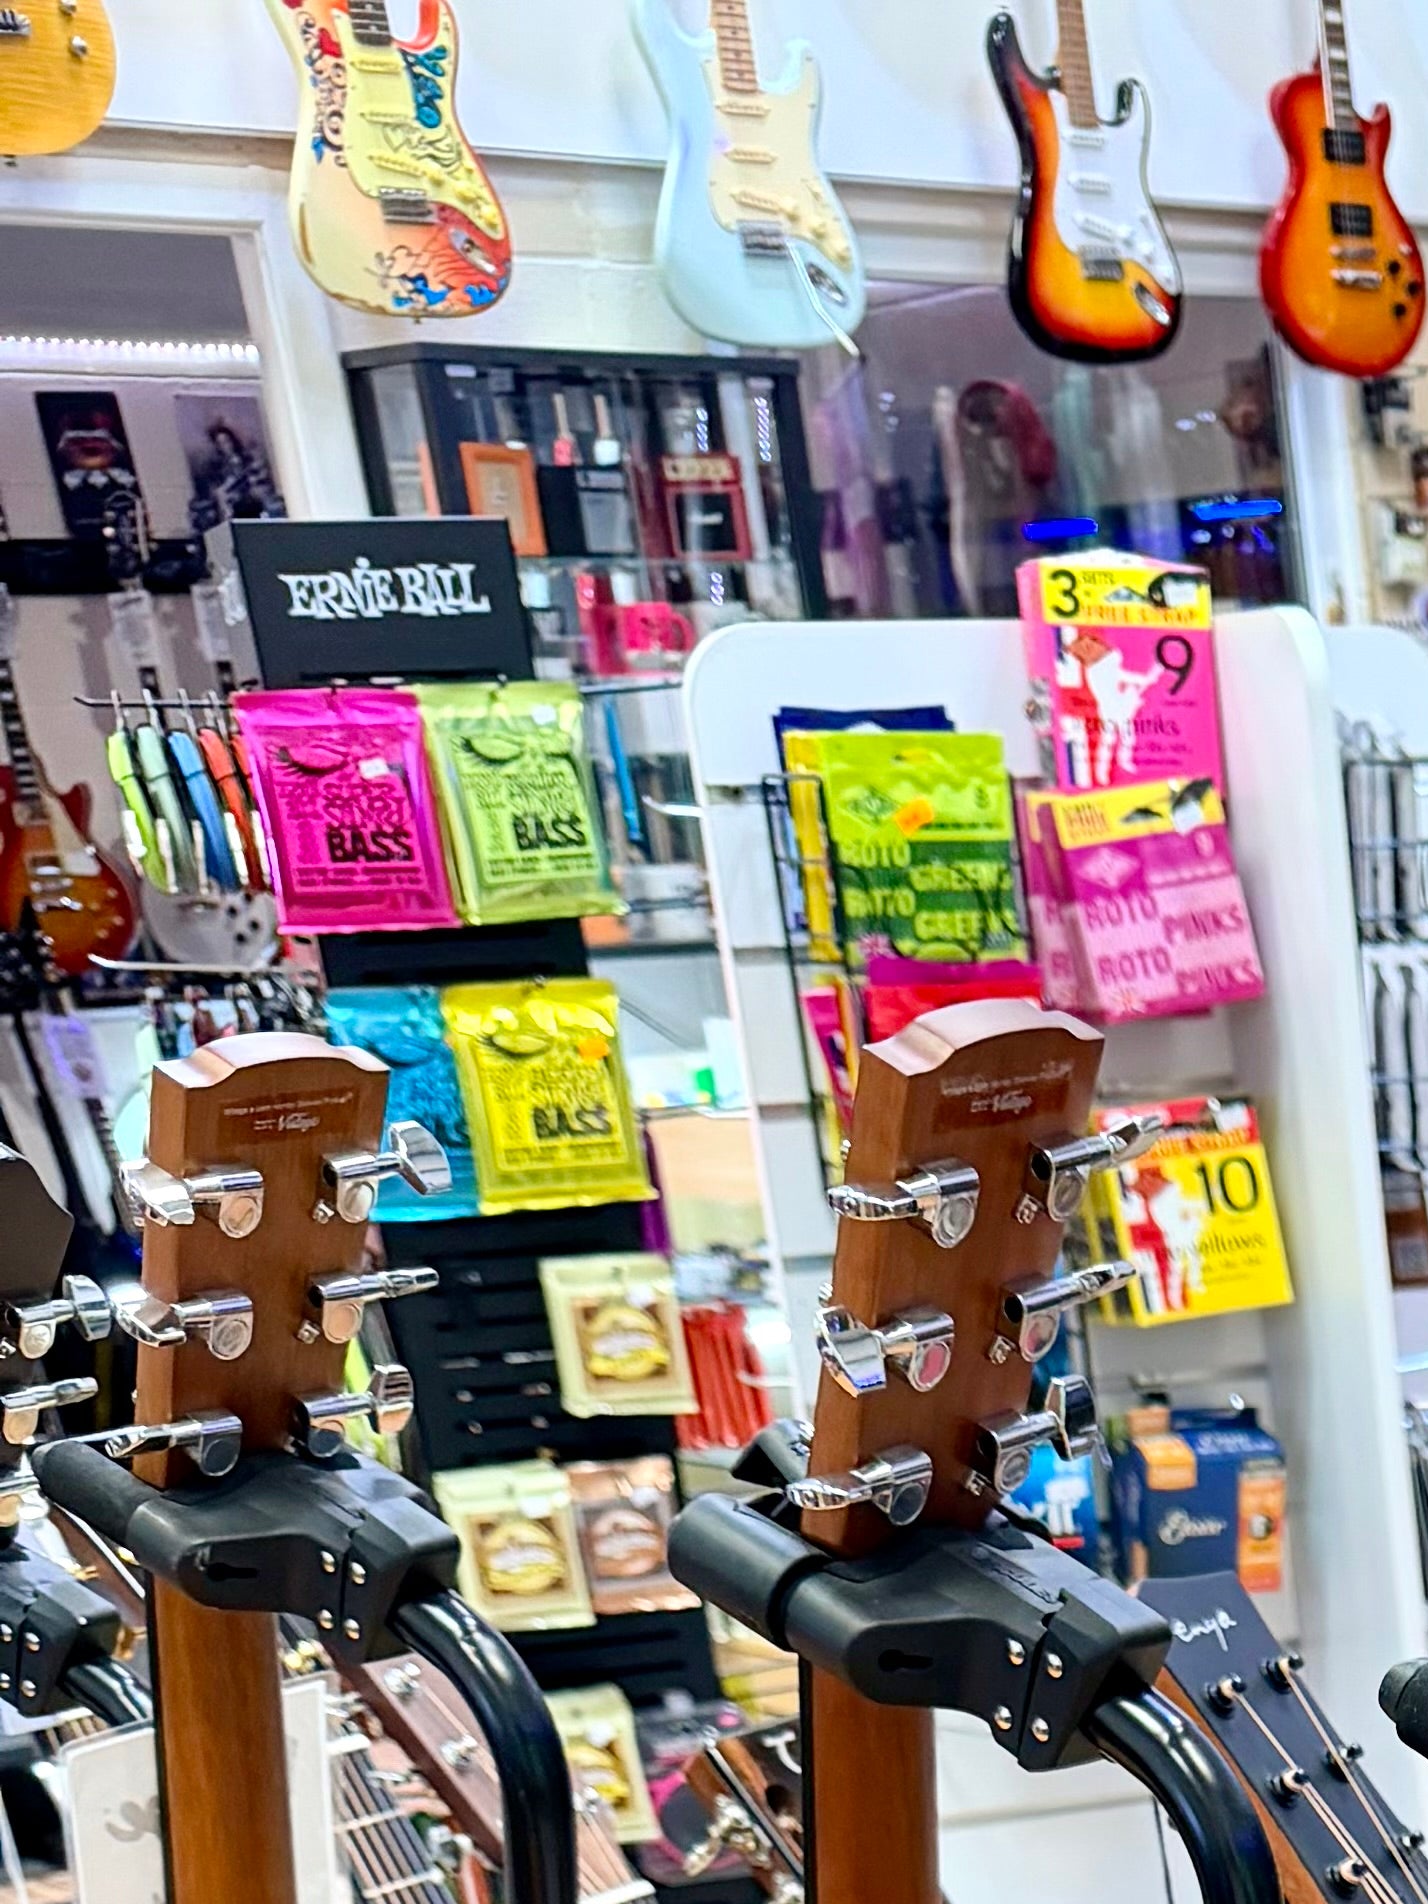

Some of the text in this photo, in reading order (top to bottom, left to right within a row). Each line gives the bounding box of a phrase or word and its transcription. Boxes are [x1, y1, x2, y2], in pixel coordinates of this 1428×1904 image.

[277, 556, 492, 620] ERNIE BALL
[1049, 568, 1081, 619] 3
[1155, 634, 1195, 696] 9
[327, 829, 414, 862] BASS
[512, 812, 587, 850] BASS
[1196, 1155, 1260, 1217] 10
